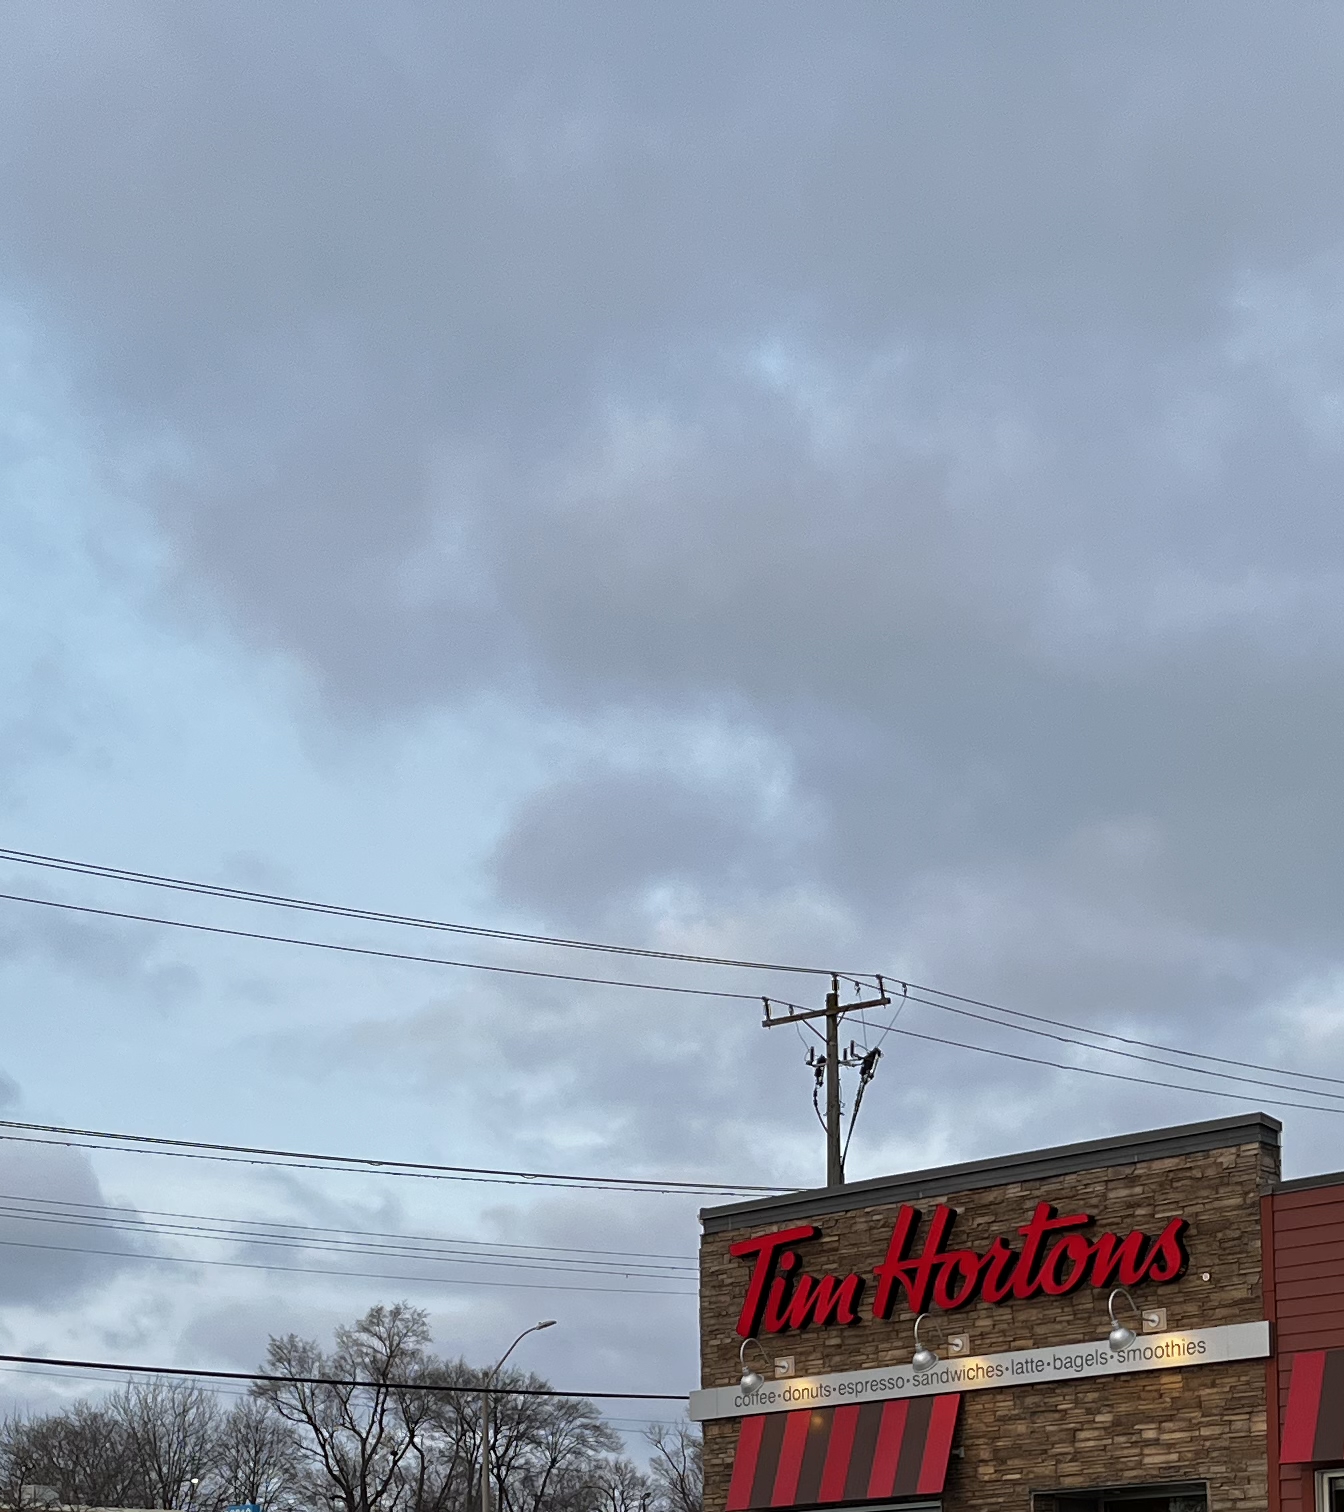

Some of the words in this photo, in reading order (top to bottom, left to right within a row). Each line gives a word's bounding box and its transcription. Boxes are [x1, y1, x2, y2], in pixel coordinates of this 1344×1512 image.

[729, 1225, 860, 1338] Tim
[872, 1202, 1189, 1318] Hortons
[783, 1382, 831, 1402] donuts
[839, 1376, 904, 1398] espresso
[912, 1363, 1004, 1387] sandwiches
[1011, 1358, 1045, 1375] latte
[1053, 1349, 1108, 1372] bagels
[1117, 1339, 1207, 1364] smoothies
